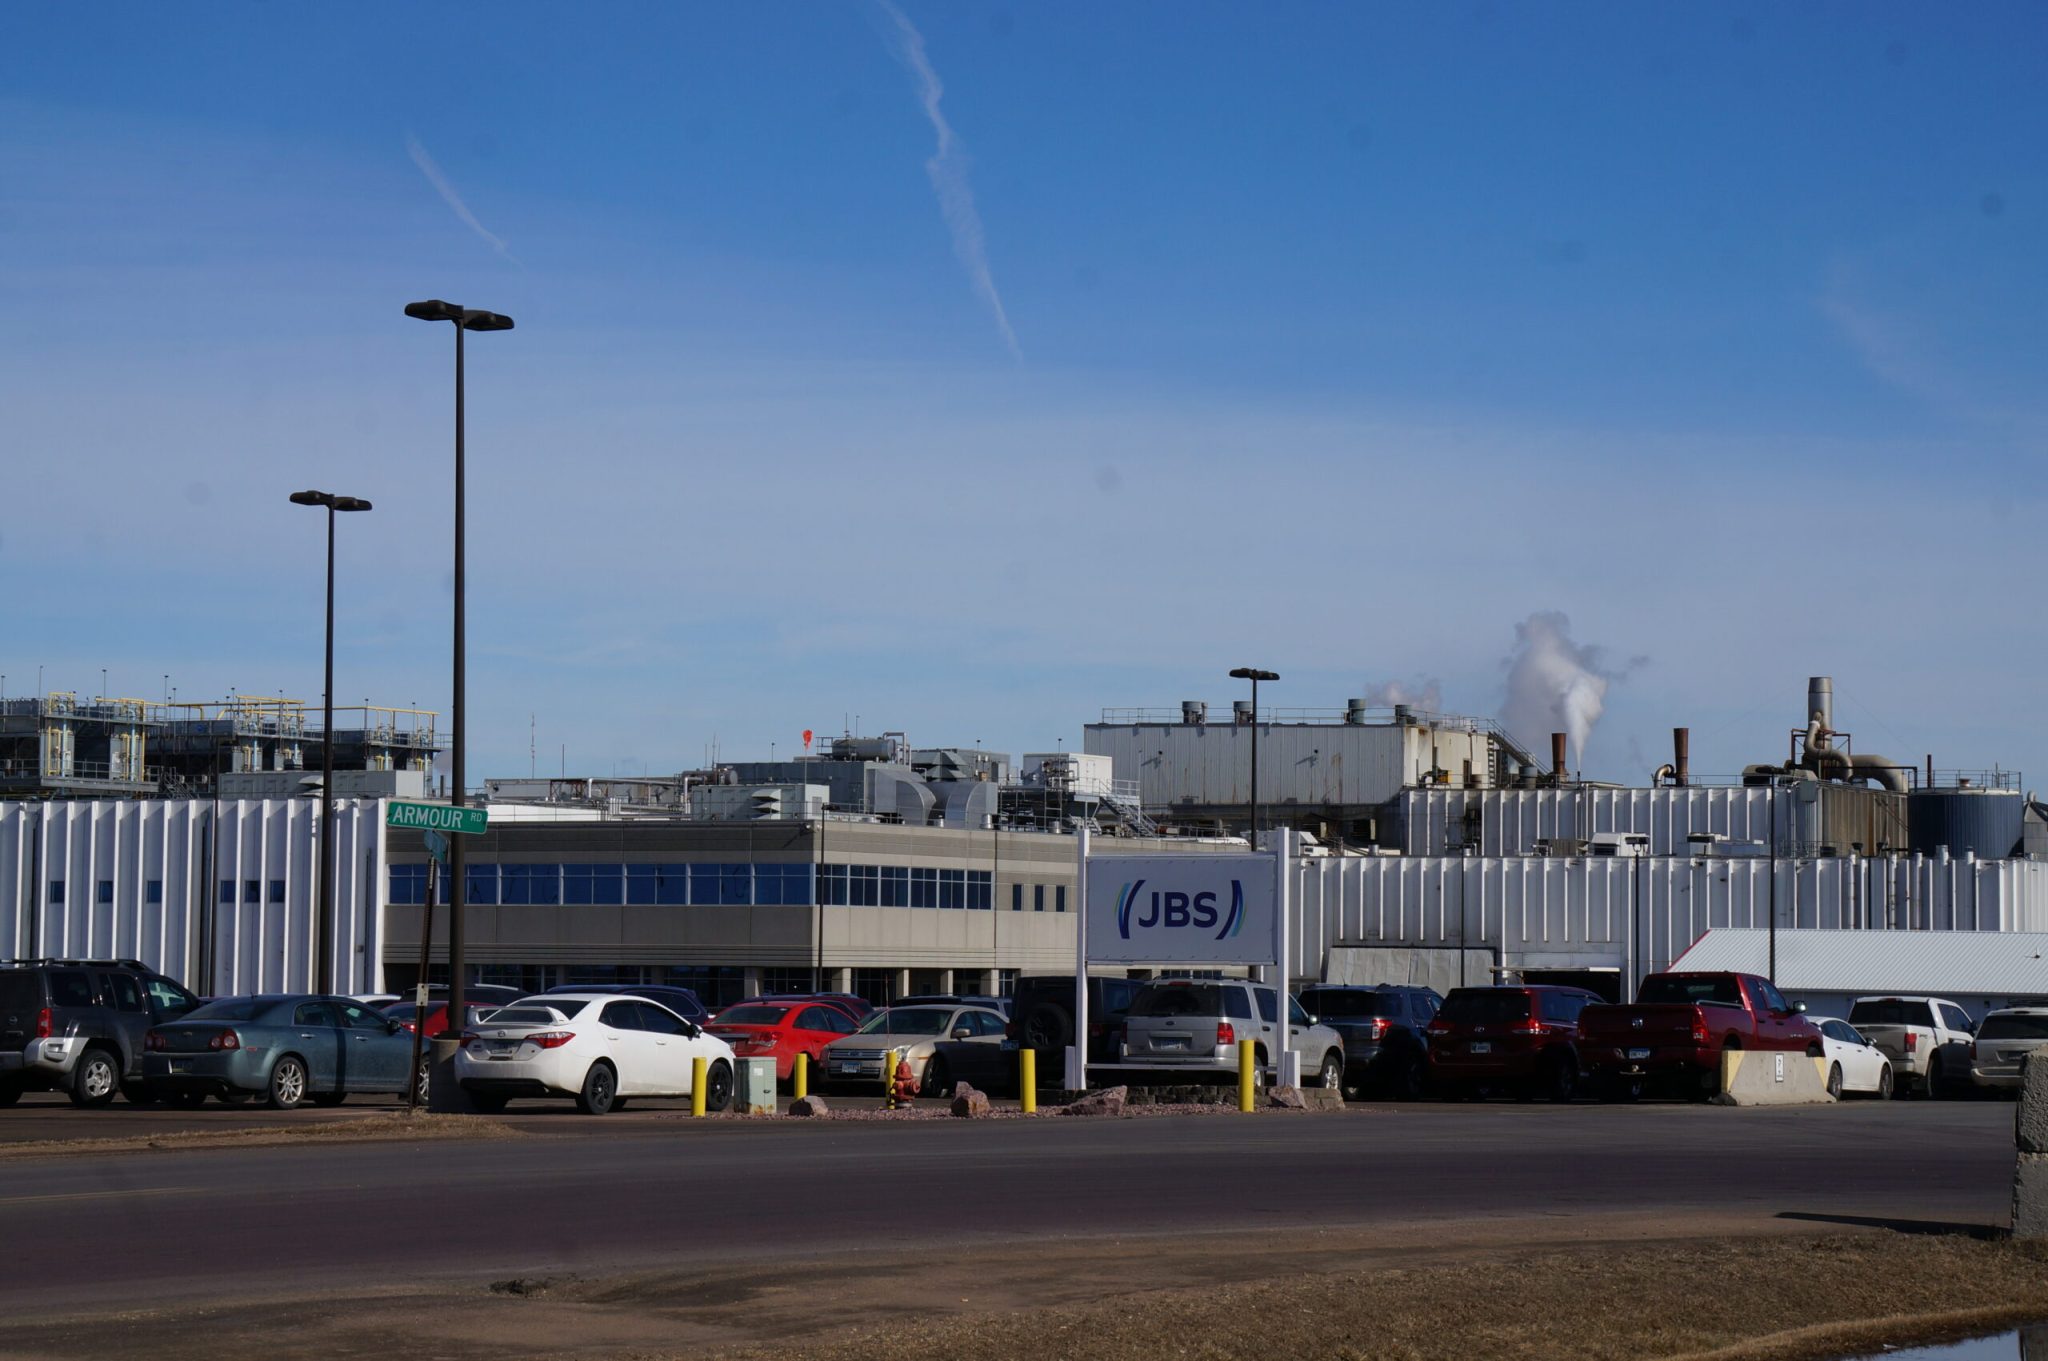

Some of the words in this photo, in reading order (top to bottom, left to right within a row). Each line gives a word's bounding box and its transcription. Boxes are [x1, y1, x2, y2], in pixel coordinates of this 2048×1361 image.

[392, 805, 463, 828] ARMOUR
[470, 812, 482, 822] RD
[1138, 891, 1218, 928] JBS
